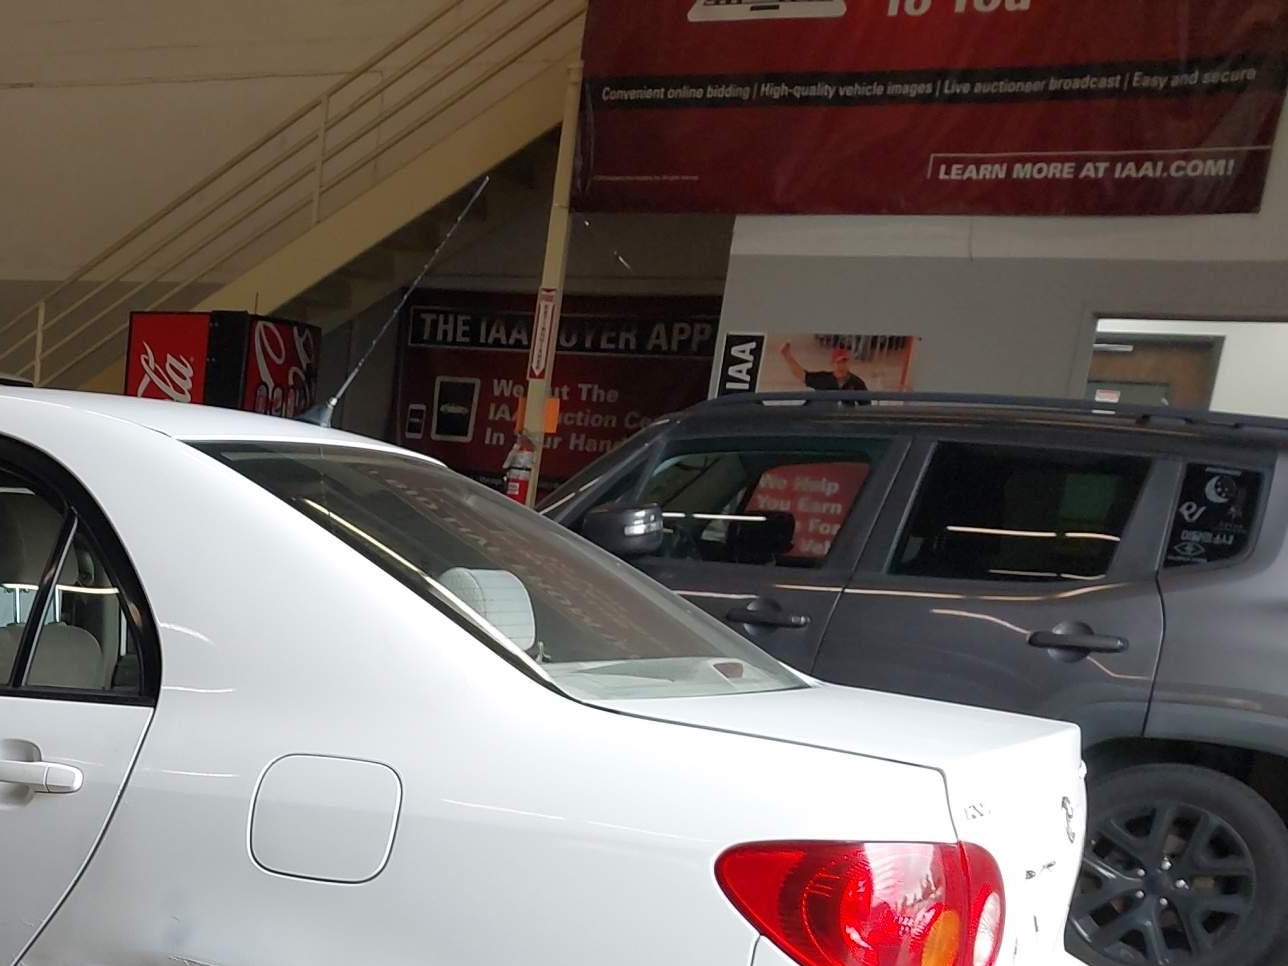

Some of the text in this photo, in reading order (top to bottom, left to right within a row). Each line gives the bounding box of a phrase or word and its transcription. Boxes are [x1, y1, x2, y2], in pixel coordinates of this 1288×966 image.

[602, 87, 665, 101] Convenient
[667, 86, 704, 99] online
[706, 84, 750, 101] bidding
[760, 81, 835, 99] High-quality
[838, 81, 884, 96] vehicle
[886, 80, 933, 98] images
[944, 79, 970, 95] Live
[973, 77, 1045, 94] auctioneer
[1048, 74, 1120, 92] broadcast
[1132, 72, 1166, 91] Easy
[1171, 70, 1198, 86] and
[1201, 68, 1256, 84] secure
[938, 159, 1235, 180] LEARN MORE AT IAAI.COM!
[419, 313, 713, 352] THE IAA UYER APP
[725, 341, 757, 391] IAA
[492, 378, 619, 403] We ut The
[484, 427, 505, 446] In
[568, 433, 614, 452] Han
